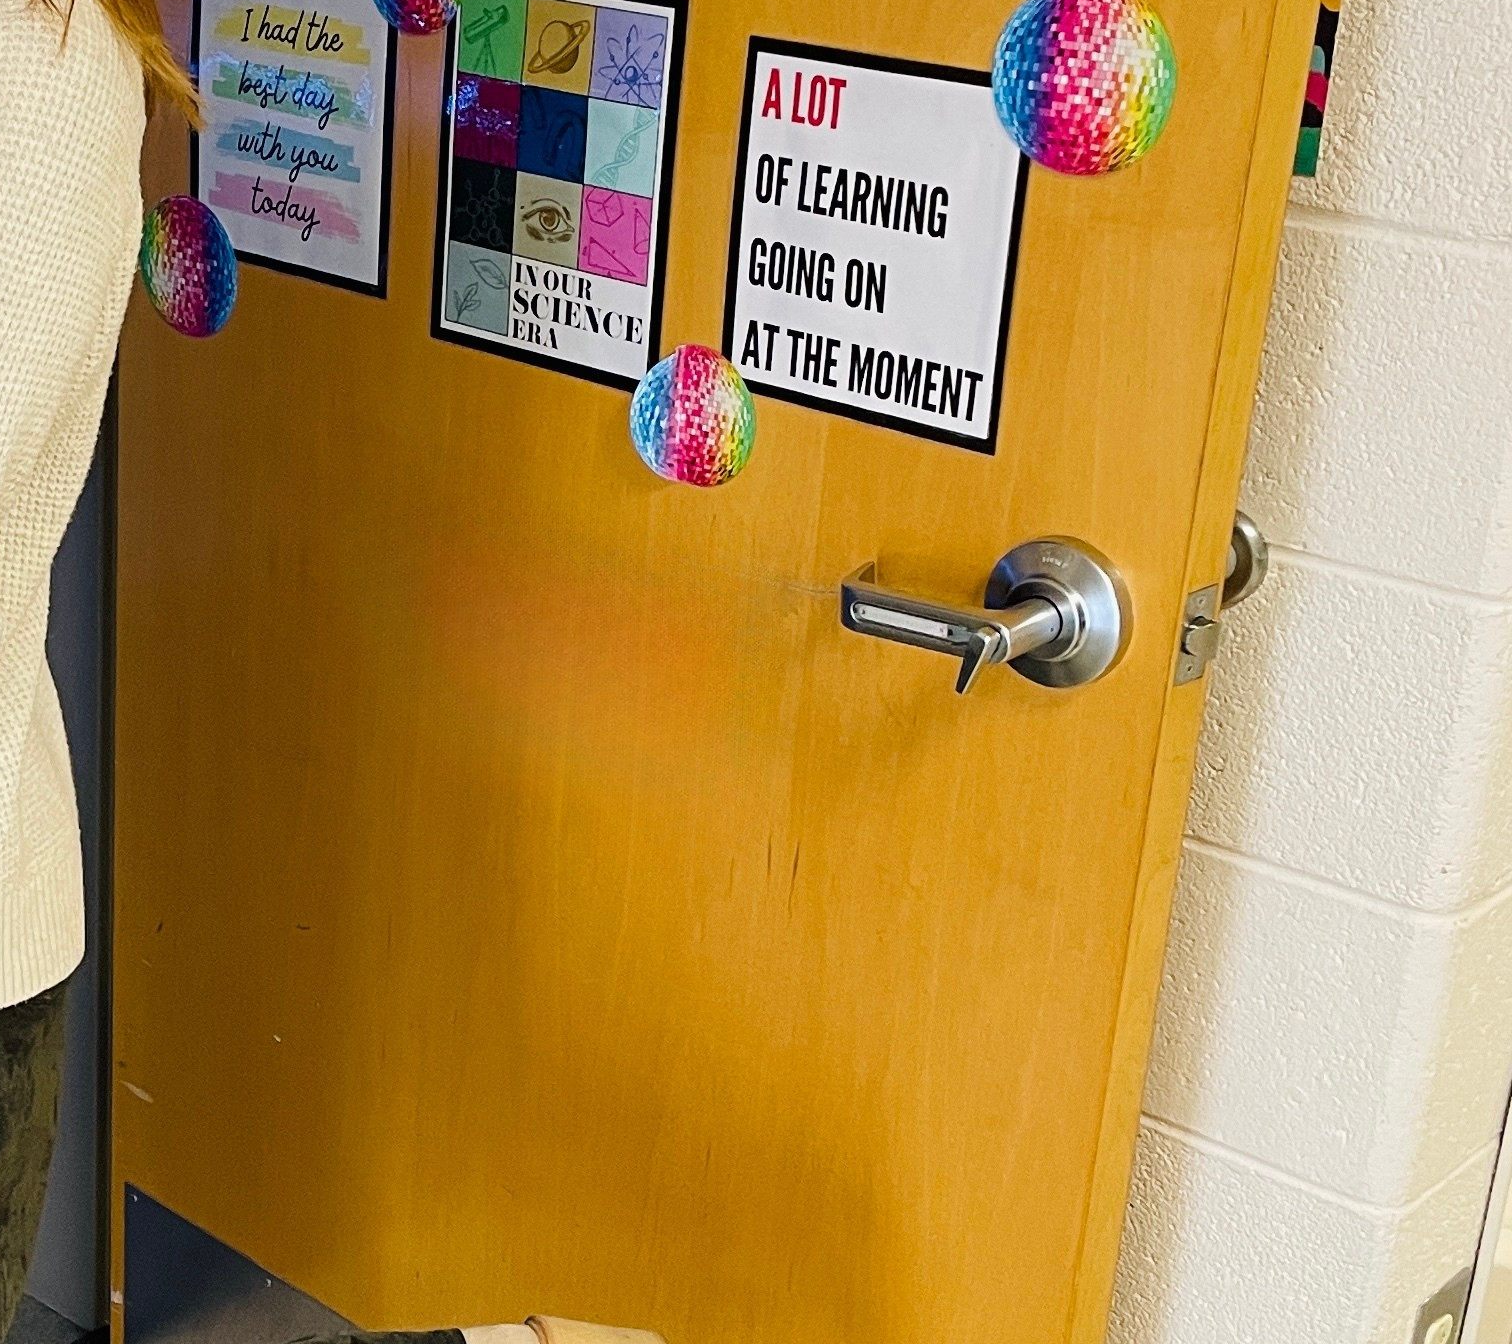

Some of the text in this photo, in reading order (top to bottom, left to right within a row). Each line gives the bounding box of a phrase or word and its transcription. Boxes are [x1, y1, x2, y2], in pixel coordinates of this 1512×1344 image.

[240, 4, 344, 52] I had the
[238, 60, 340, 130] best day
[761, 68, 847, 130] A LOT
[238, 121, 339, 183] with you
[251, 176, 320, 242] today
[755, 153, 949, 239] OF LEARNING
[515, 262, 592, 300] IN OUR
[748, 237, 887, 314] GOING ON
[512, 288, 643, 344] SCIENCE
[512, 318, 558, 349] ERA
[740, 319, 984, 422] AT THE MOMENT
